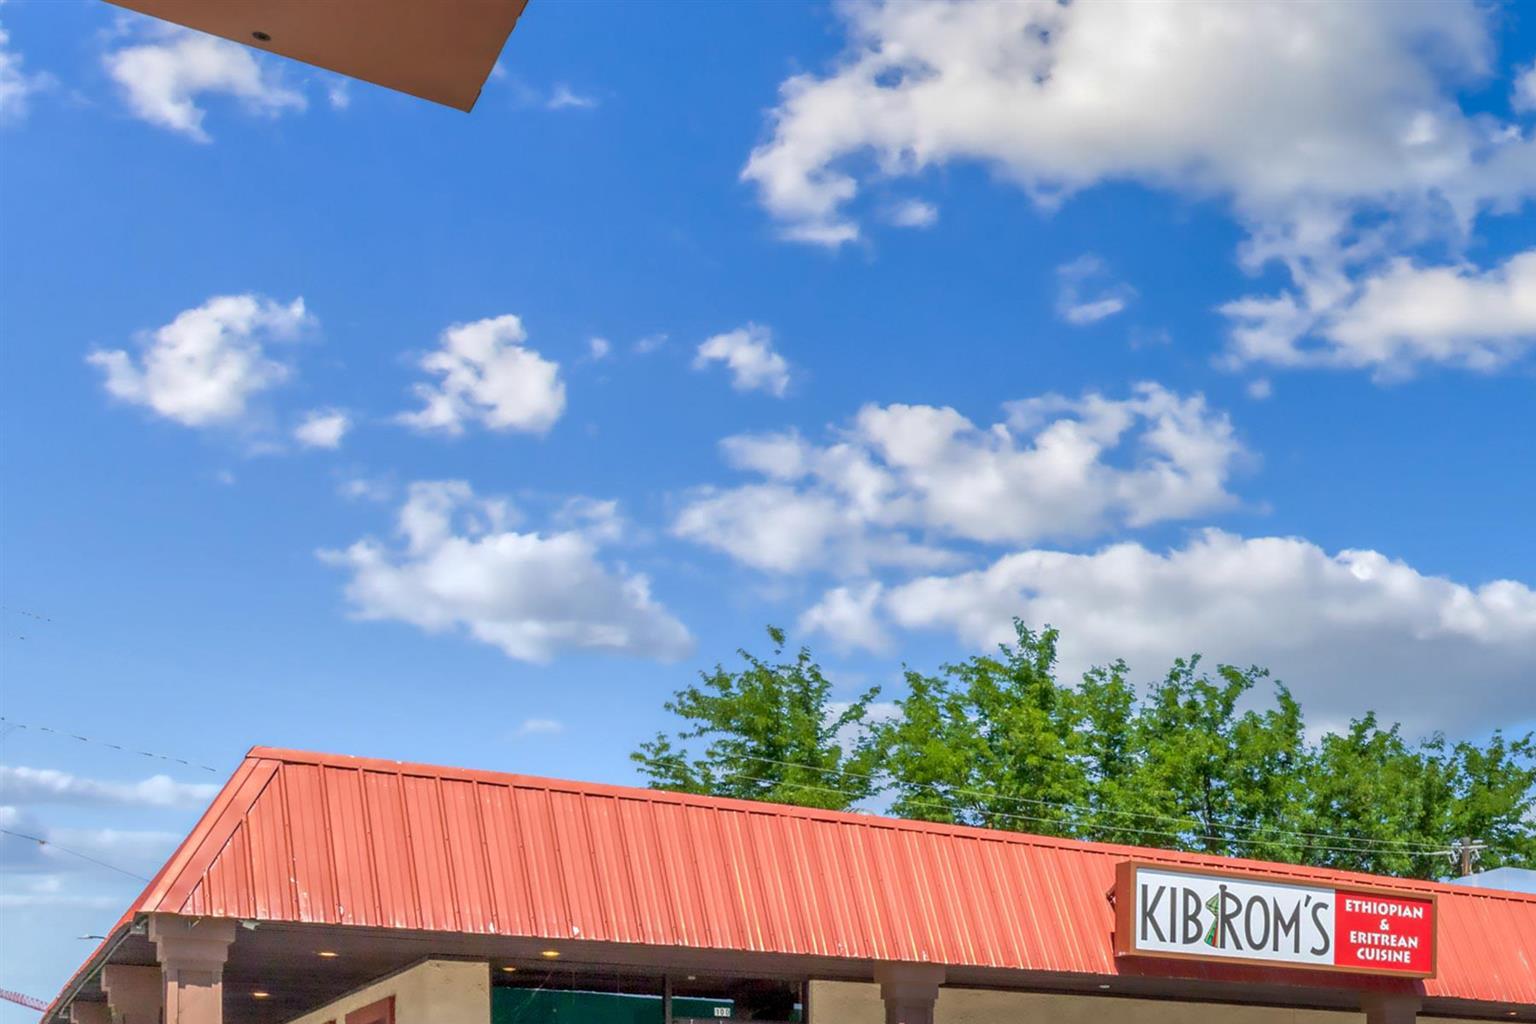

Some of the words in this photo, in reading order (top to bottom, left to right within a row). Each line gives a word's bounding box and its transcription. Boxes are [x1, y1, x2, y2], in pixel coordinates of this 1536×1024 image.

[1345, 898, 1423, 919] ETHIOPIAN
[1141, 884, 1330, 956] KIBROM'S
[1379, 919, 1390, 931] &
[1349, 930, 1418, 949] ERITREAN
[1356, 949, 1411, 964] CUISINE
